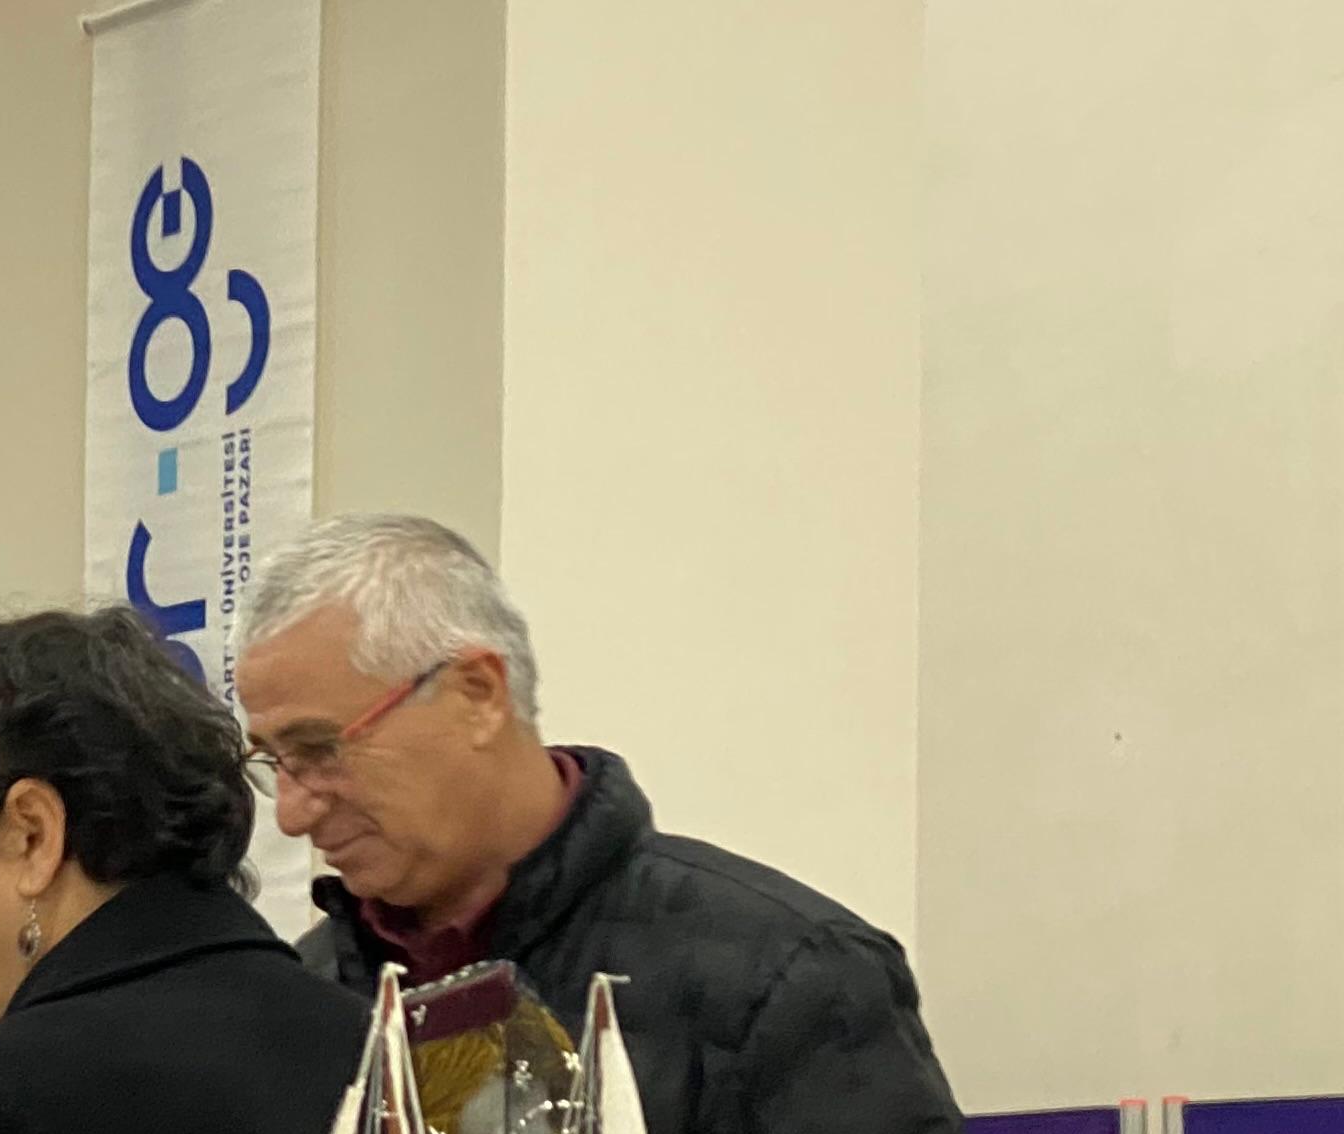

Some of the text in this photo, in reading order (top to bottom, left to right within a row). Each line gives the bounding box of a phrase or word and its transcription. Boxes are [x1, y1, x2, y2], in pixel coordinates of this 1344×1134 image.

[220, 432, 236, 615] ÜNİVERSİTESİ
[237, 427, 251, 586] OJE PAZARI
